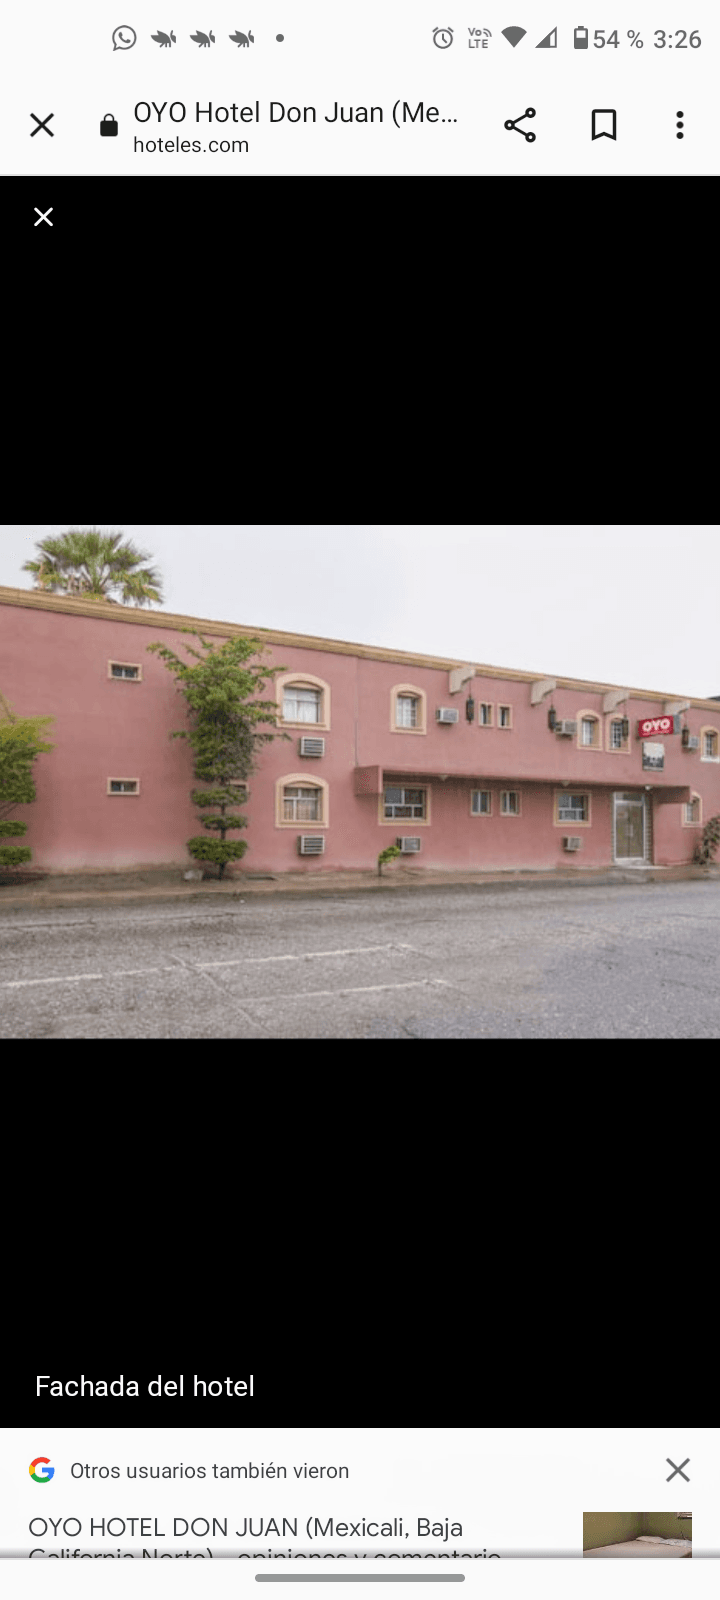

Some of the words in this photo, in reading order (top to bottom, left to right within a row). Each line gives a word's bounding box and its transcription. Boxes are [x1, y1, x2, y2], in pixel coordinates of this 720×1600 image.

[468, 38, 489, 49] LTE
[593, 29, 621, 49] 54
[626, 29, 644, 49] %
[653, 29, 702, 49] 3:26
[134, 101, 187, 123] OYO
[195, 100, 260, 123] Hotel
[269, 101, 317, 123] Don
[324, 101, 384, 123] Juan
[133, 135, 249, 153] hoteles.com
[642, 718, 670, 732] OYO
[36, 1374, 140, 1397] Fachada
[147, 1374, 184, 1397] del
[193, 1374, 254, 1397] hotel
[70, 1462, 121, 1479] Otros
[127, 1462, 207, 1479] usuarios
[212, 1461, 287, 1479] también
[292, 1462, 350, 1479] vieron
[28, 1517, 83, 1537] OYO
[90, 1517, 166, 1537] HOTEL
[173, 1517, 228, 1537] DON
[235, 1517, 298, 1537] JUAN
[306, 1516, 410, 1540] (Mexicali,
[417, 1517, 463, 1543] Baja
